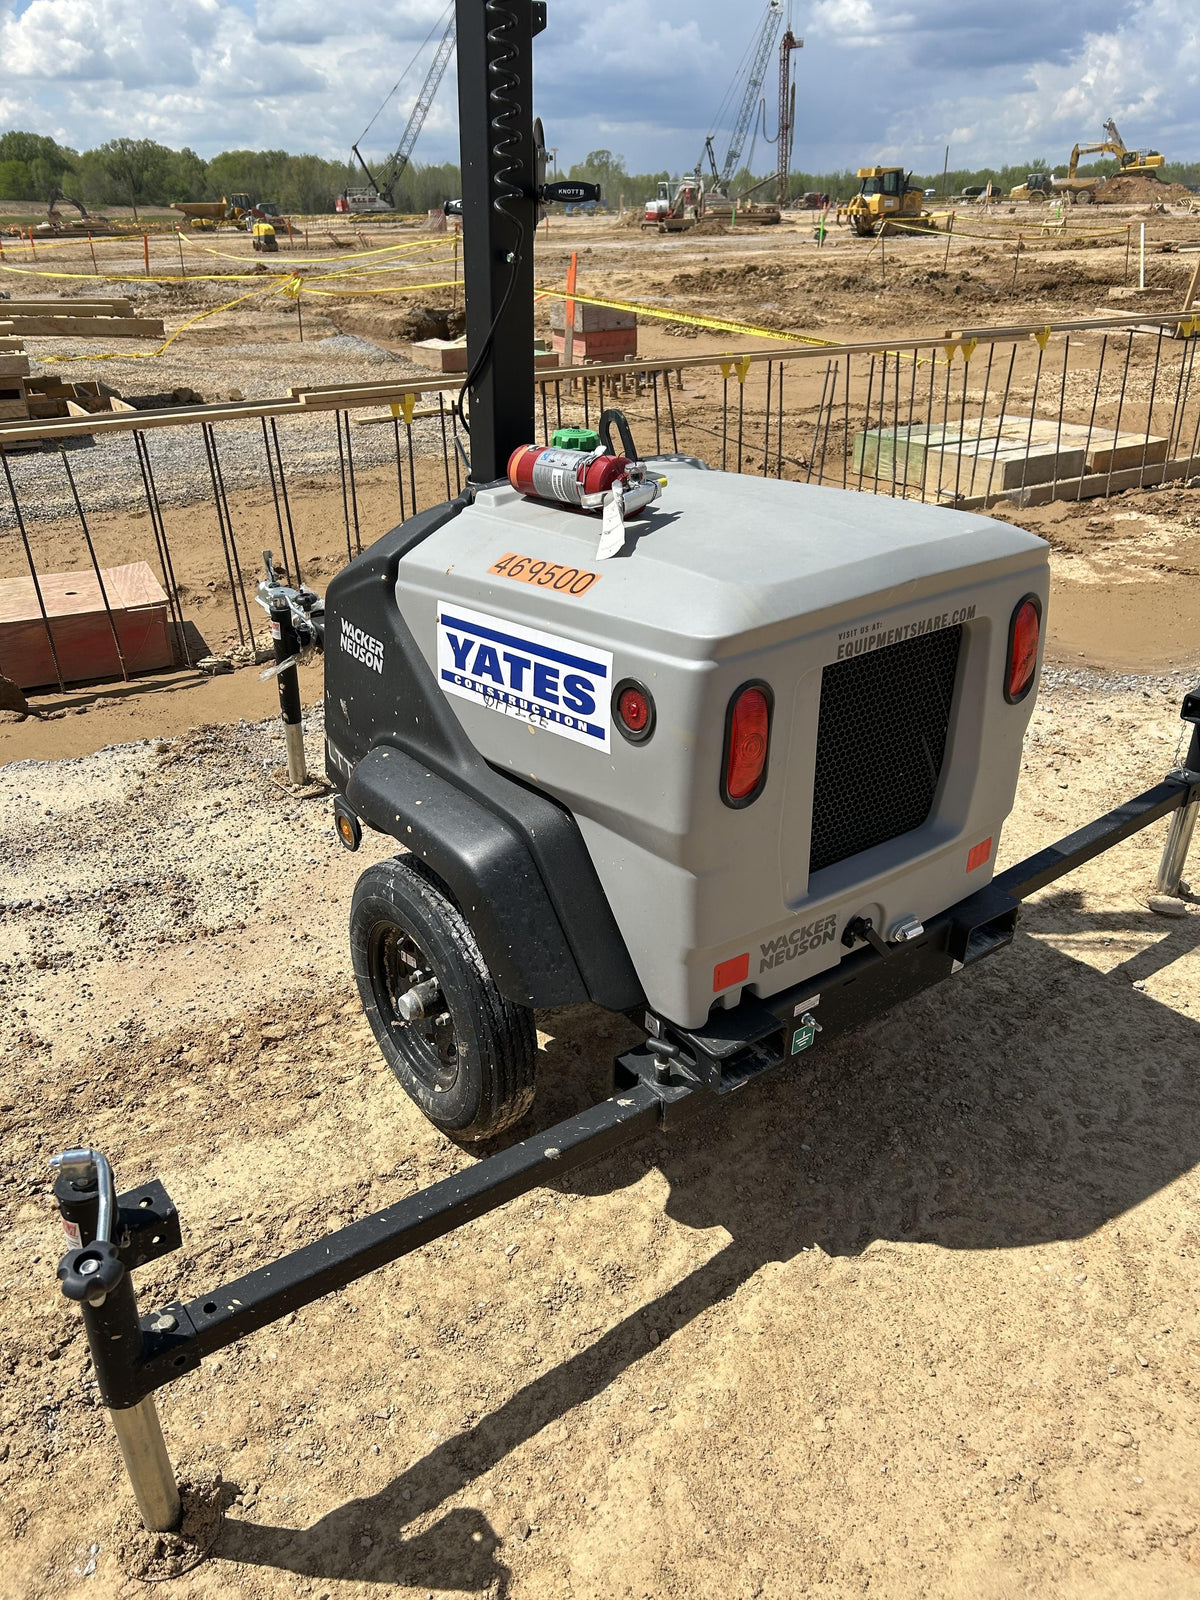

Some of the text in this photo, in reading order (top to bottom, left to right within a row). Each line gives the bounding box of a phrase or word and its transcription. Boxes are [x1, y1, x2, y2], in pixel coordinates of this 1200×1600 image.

[494, 555, 596, 594] 469500
[340, 617, 384, 659] WACKER
[836, 604, 977, 660] EQUIPMENTSHARE.COM
[838, 622, 883, 641] VISIT US AT:
[339, 633, 384, 675] NEUSON
[445, 632, 596, 716] YATES
[454, 675, 588, 733] CONSTRUCTION
[759, 914, 837, 957] WACKER
[759, 927, 836, 974] NEUSON
